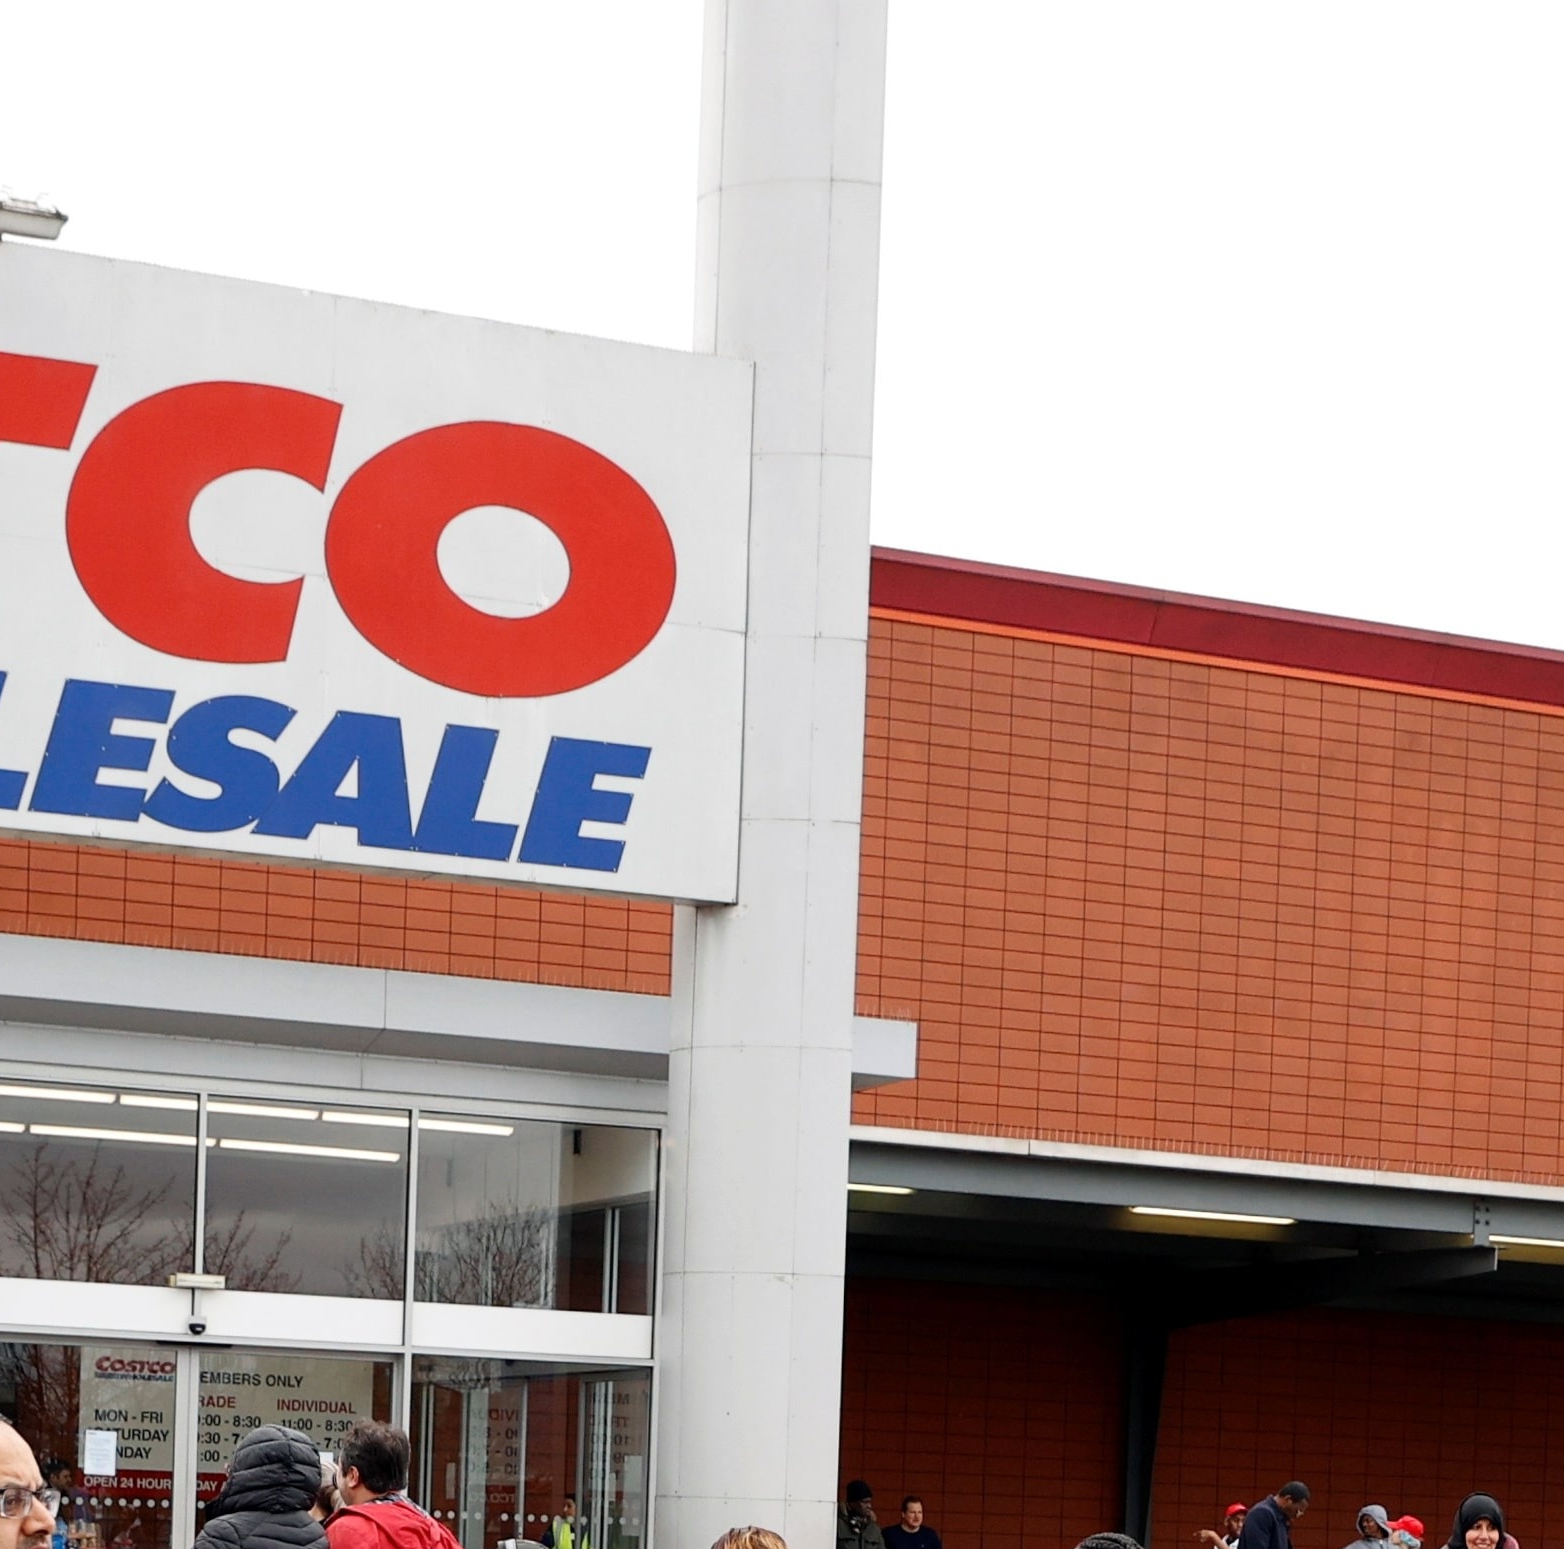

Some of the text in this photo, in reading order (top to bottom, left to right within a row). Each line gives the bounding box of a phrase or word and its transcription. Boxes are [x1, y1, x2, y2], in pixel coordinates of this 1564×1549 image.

[96, 1356, 175, 1374] COSTCO
[200, 1371, 304, 1388] EMBERS ONLY
[198, 1396, 357, 1414] RADE INDIVIDUAL
[95, 1409, 128, 1422] MON
[141, 1411, 163, 1424] FRI
[198, 1414, 221, 1426] :00
[233, 1416, 261, 1428] 8:30
[325, 1420, 354, 1432] 8:30
[198, 1432, 220, 1444] :30
[116, 1446, 152, 1459] NDAY
[200, 1450, 220, 1462] :00
[83, 1476, 118, 1488] OPEN
[120, 1477, 134, 1488] 24
[137, 1478, 172, 1490] HOUR
